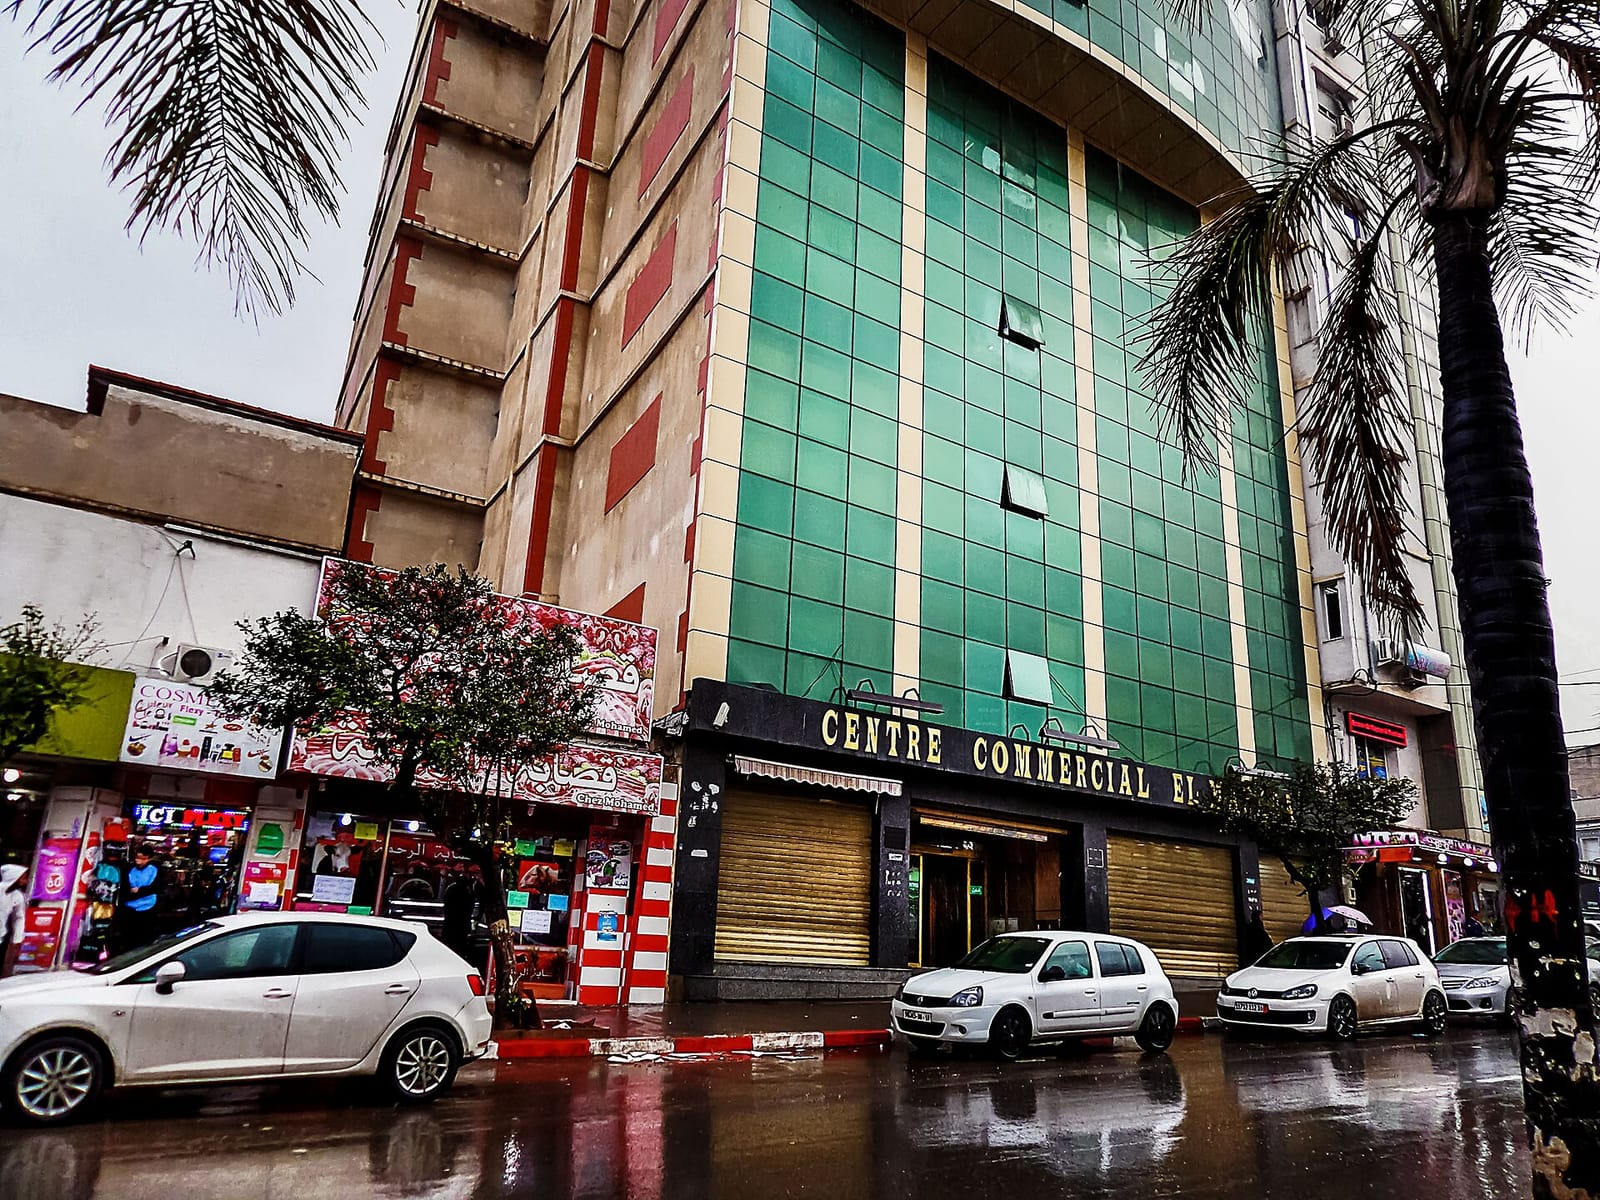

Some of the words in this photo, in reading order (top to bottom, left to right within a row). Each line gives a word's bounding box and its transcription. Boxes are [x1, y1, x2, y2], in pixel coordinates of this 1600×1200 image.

[596, 718, 643, 734] Mohamed
[821, 708, 942, 764] CENTRE
[973, 736, 1150, 799] COMMERCIAL
[576, 793, 603, 805] Chez
[605, 797, 655, 812] Mohamed
[139, 807, 176, 824] ICI
